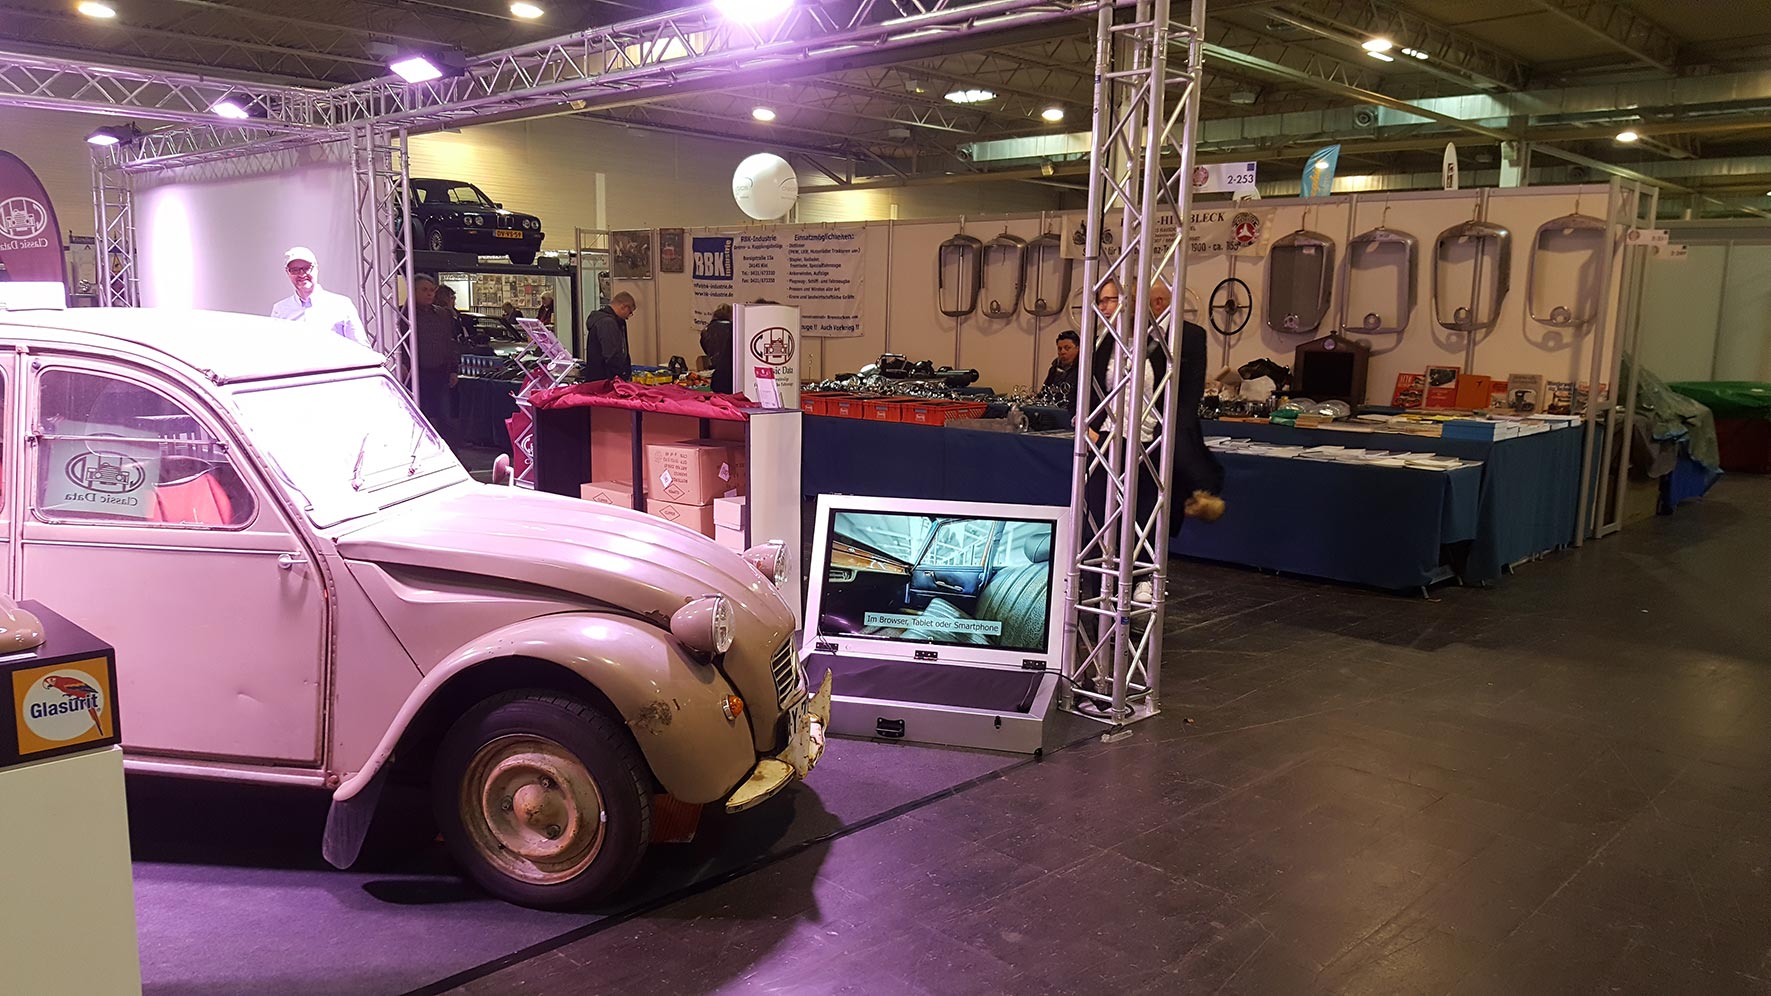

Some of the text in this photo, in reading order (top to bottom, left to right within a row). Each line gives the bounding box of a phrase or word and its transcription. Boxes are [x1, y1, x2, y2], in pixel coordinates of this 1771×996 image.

[1227, 174, 1254, 184] 2-253
[867, 615, 999, 632] Im Browser, Tablet oder Smartphone
[30, 693, 98, 718] Glasurit
